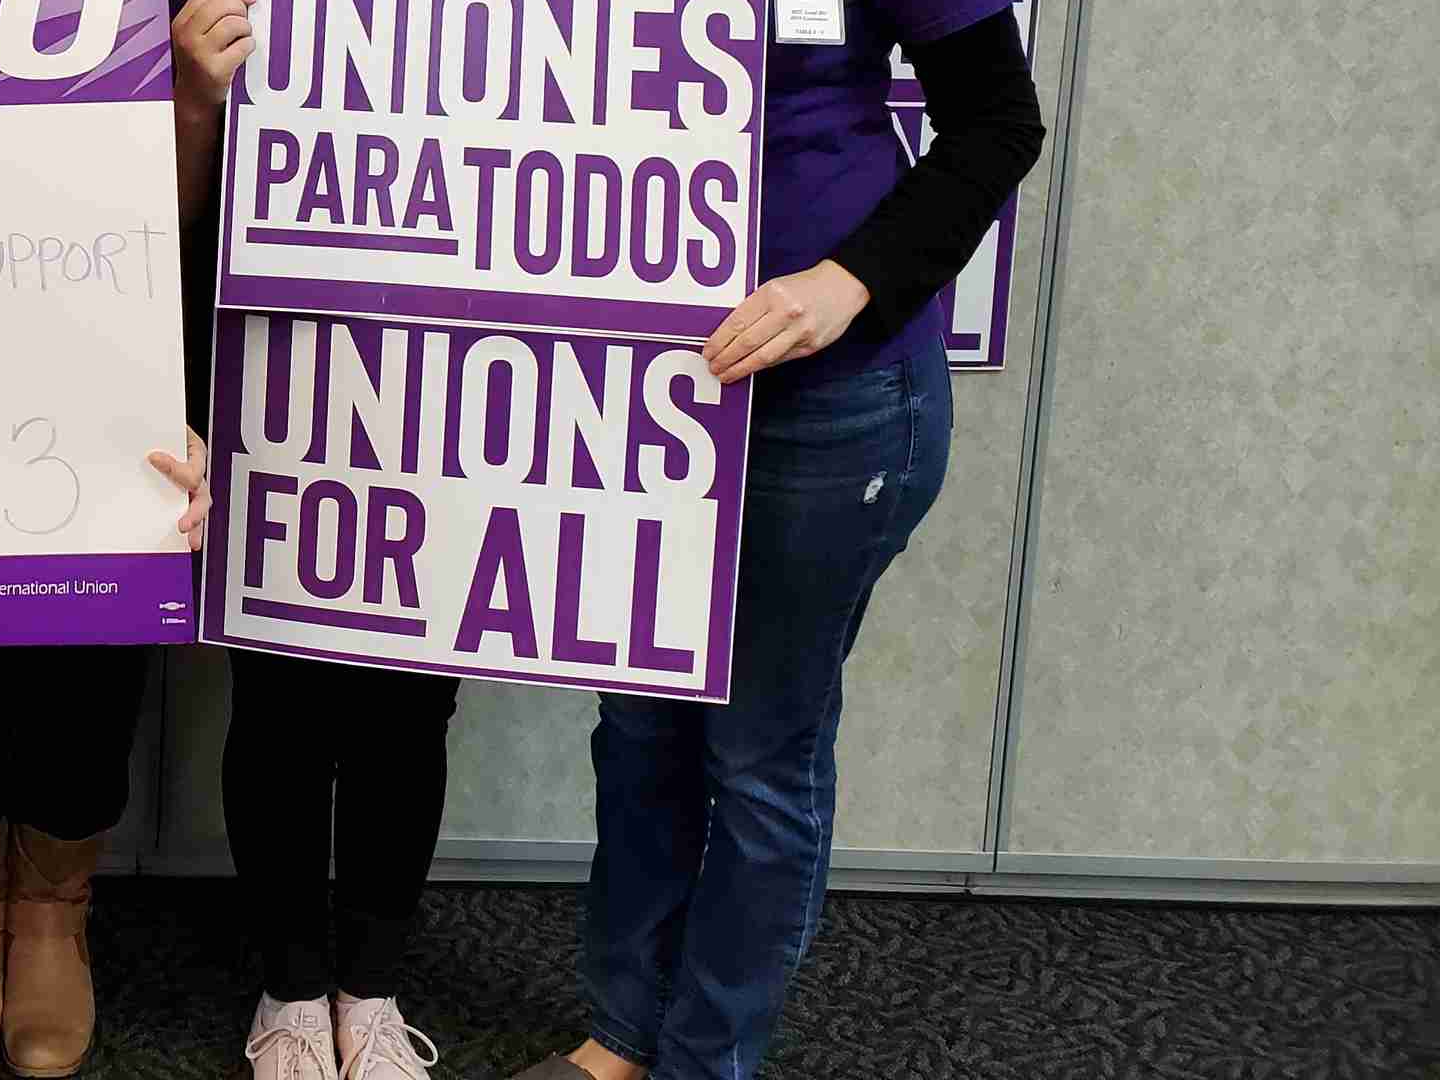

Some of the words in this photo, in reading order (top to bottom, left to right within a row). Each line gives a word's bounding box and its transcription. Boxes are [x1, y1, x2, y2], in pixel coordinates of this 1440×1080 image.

[254, 128, 454, 231] PARA
[463, 146, 738, 288] TODOS
[241, 314, 722, 498] UNIONS
[73, 579, 119, 595] Union
[243, 470, 427, 609] FOR
[452, 506, 696, 675] ALL
